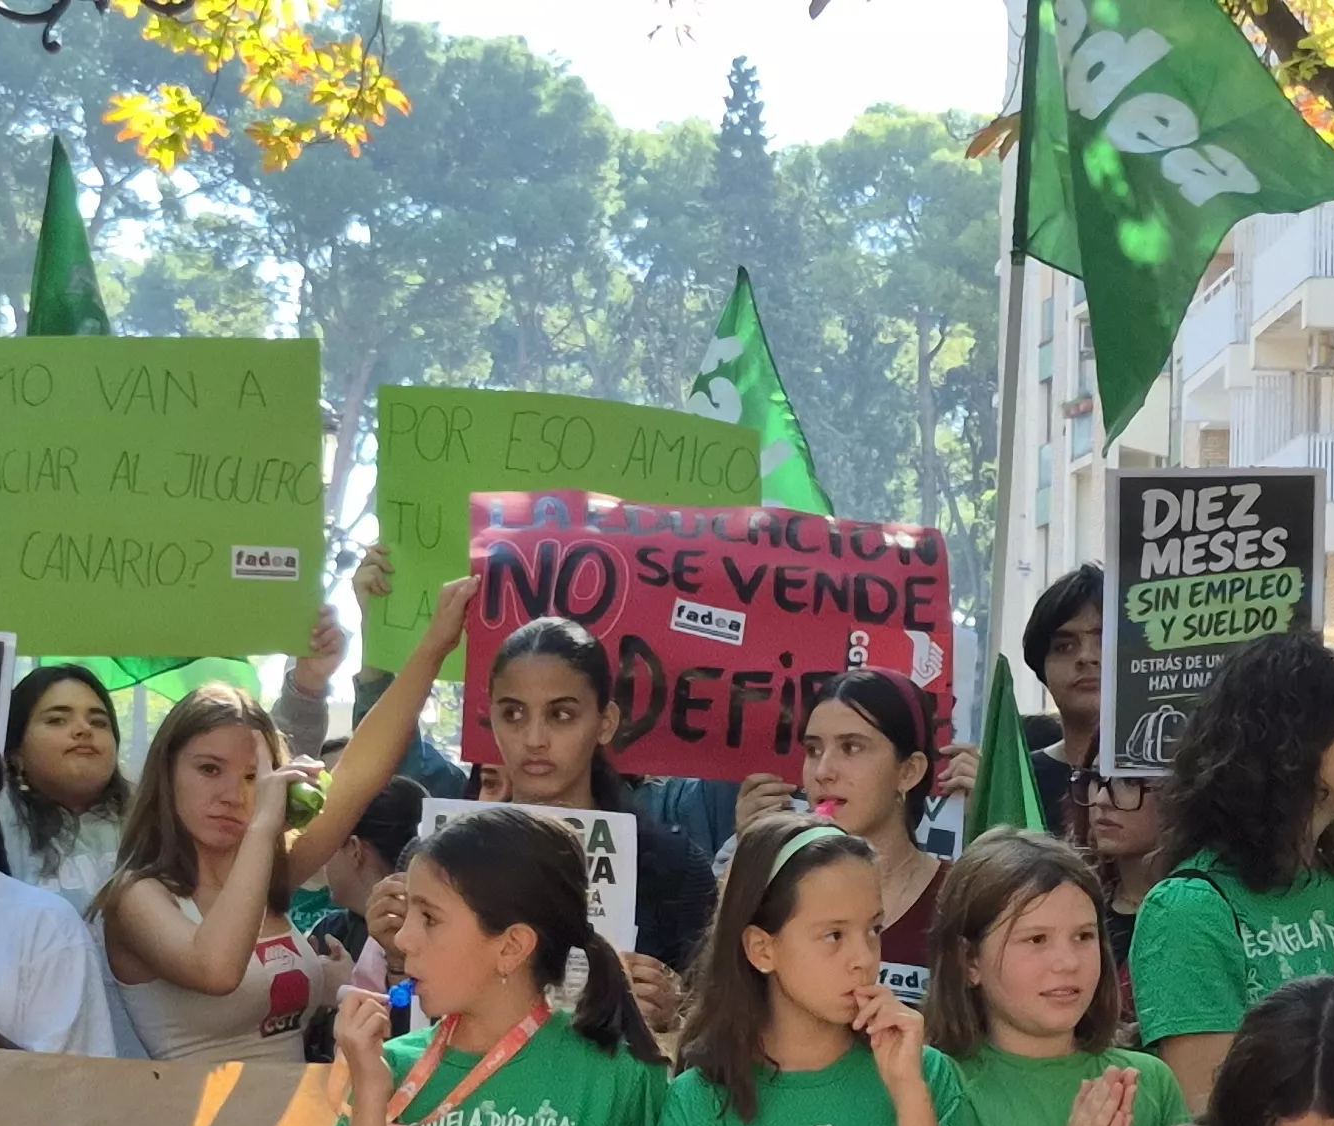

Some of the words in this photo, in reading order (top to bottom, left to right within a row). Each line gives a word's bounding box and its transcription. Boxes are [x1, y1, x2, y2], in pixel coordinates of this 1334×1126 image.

[96, 365, 198, 411] VAN
[238, 370, 267, 409] A
[383, 402, 473, 465] POR
[504, 410, 596, 475] ESO
[621, 425, 761, 495] AMIGO
[110, 451, 149, 496] AL
[165, 452, 322, 506] JILGUERO
[387, 499, 442, 549] TU
[489, 496, 570, 532] LA
[1140, 483, 1262, 541] DIEZ
[20, 530, 214, 590] CANARIO?
[1140, 527, 1289, 580] MESES
[485, 538, 618, 626] NO
[635, 545, 706, 594] SE
[721, 555, 938, 633] VENDE
[1137, 584, 1181, 616] SIN
[1189, 573, 1293, 610] EMPLEO
[676, 604, 741, 633] fadea
[1159, 616, 1178, 644] Y
[1183, 607, 1278, 642] SUELDO
[1130, 653, 1183, 674] DETRÁS
[1185, 655, 1203, 670] DE
[1148, 674, 1178, 691] HAY
